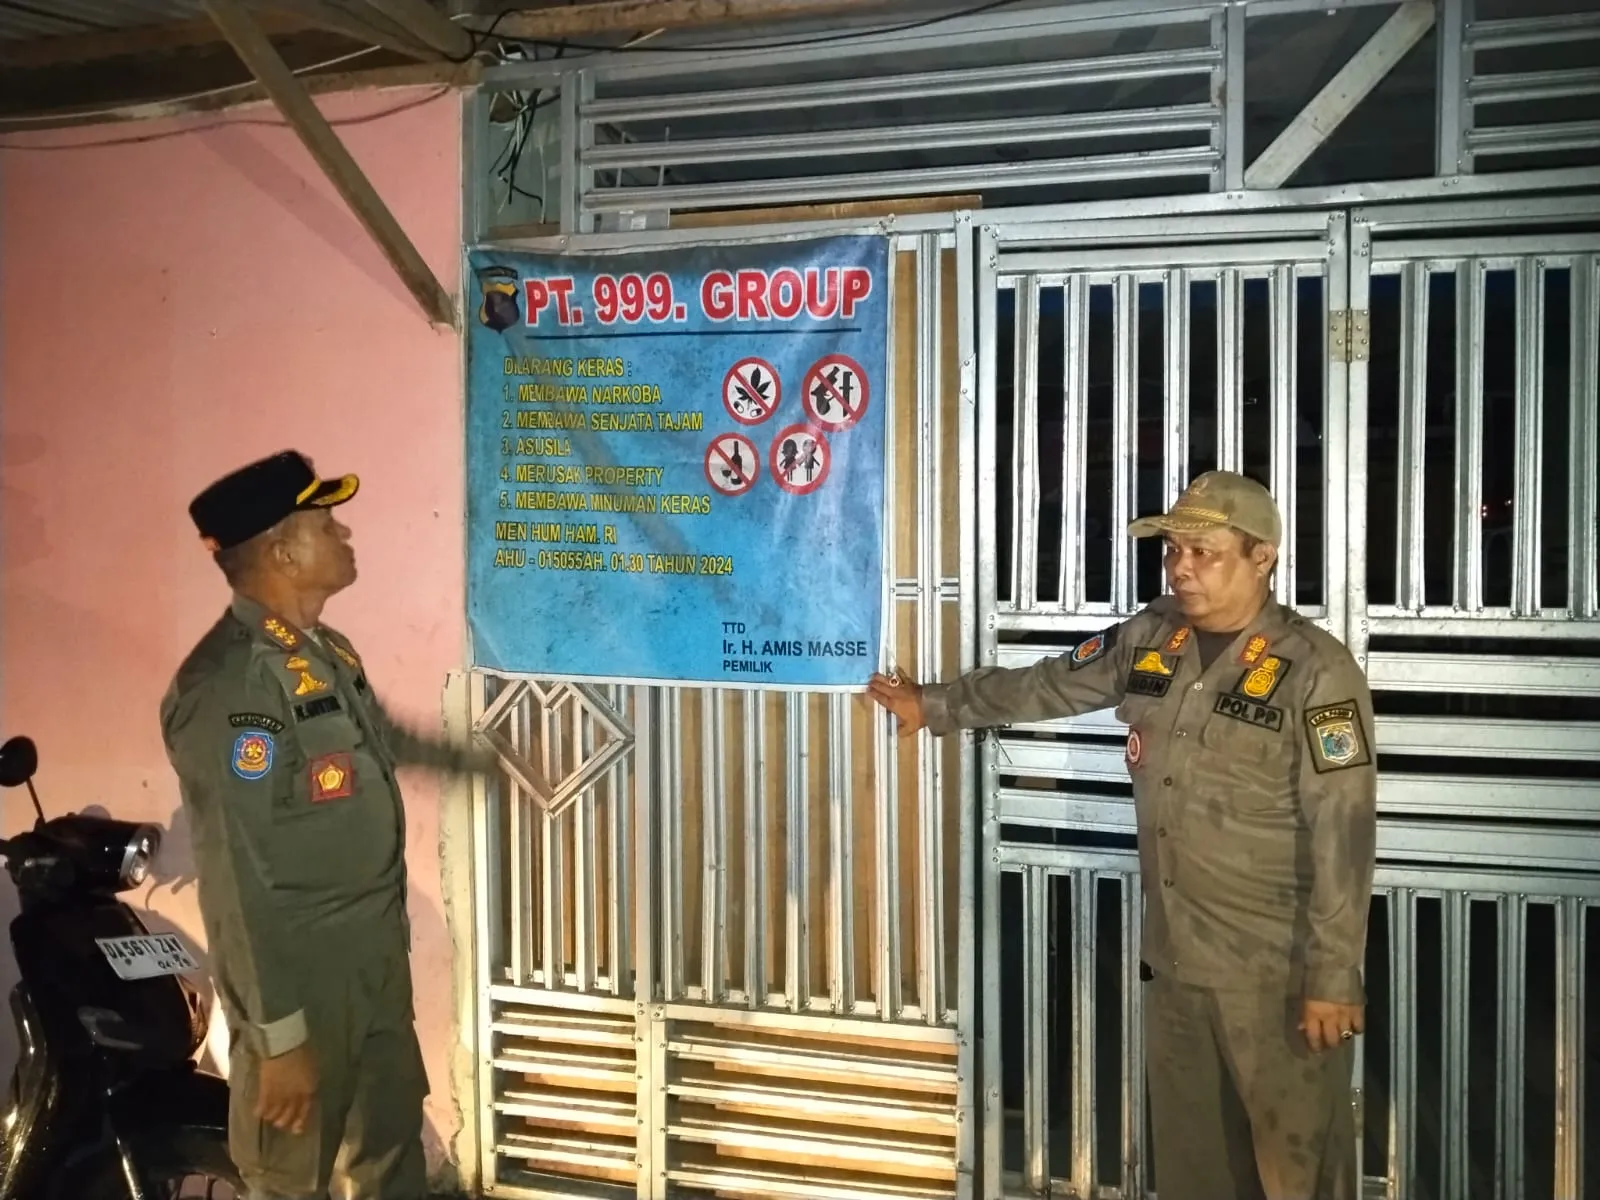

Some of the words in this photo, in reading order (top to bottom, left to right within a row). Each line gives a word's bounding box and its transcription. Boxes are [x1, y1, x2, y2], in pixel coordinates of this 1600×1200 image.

[523, 278, 583, 327] PT.
[593, 272, 688, 324] 999.
[701, 267, 872, 322] GROUP
[504, 357, 573, 376] DILARANG
[577, 358, 624, 377] KERAS
[502, 385, 514, 400] 1.
[518, 384, 588, 403] MEMBAWA
[592, 385, 662, 404] NARKOBA
[502, 411, 513, 429] 2.
[516, 410, 586, 429] MEMBAWA
[591, 412, 654, 431] SENJATA
[656, 412, 703, 431] TAJAM
[502, 438, 511, 455] 3.
[515, 437, 571, 456] ASUSILA
[500, 465, 512, 482] 4.
[516, 464, 581, 483] MERUSAK
[585, 466, 664, 486] PROPERTY
[499, 493, 512, 509] 5.
[515, 491, 587, 511] MEMBAWA
[590, 493, 656, 513] MINUMAN
[660, 495, 711, 514] KERAS
[495, 521, 527, 540] MEN
[530, 523, 560, 542] HUM
[564, 523, 600, 543] HAM.
[604, 525, 617, 544] RI
[494, 549, 525, 568] AHU
[538, 551, 607, 571] 015055AH.
[610, 553, 644, 573] 01.30
[649, 554, 696, 574] TAHUN
[700, 556, 733, 575] 2024
[722, 622, 746, 634] TTD
[723, 640, 737, 655] Ir.
[742, 640, 757, 655] H.
[761, 641, 802, 656] AMIS
[808, 641, 867, 656] MASSE
[723, 660, 773, 673] PEMILIK
[1219, 695, 1249, 720] POL
[1253, 707, 1279, 725] PP
